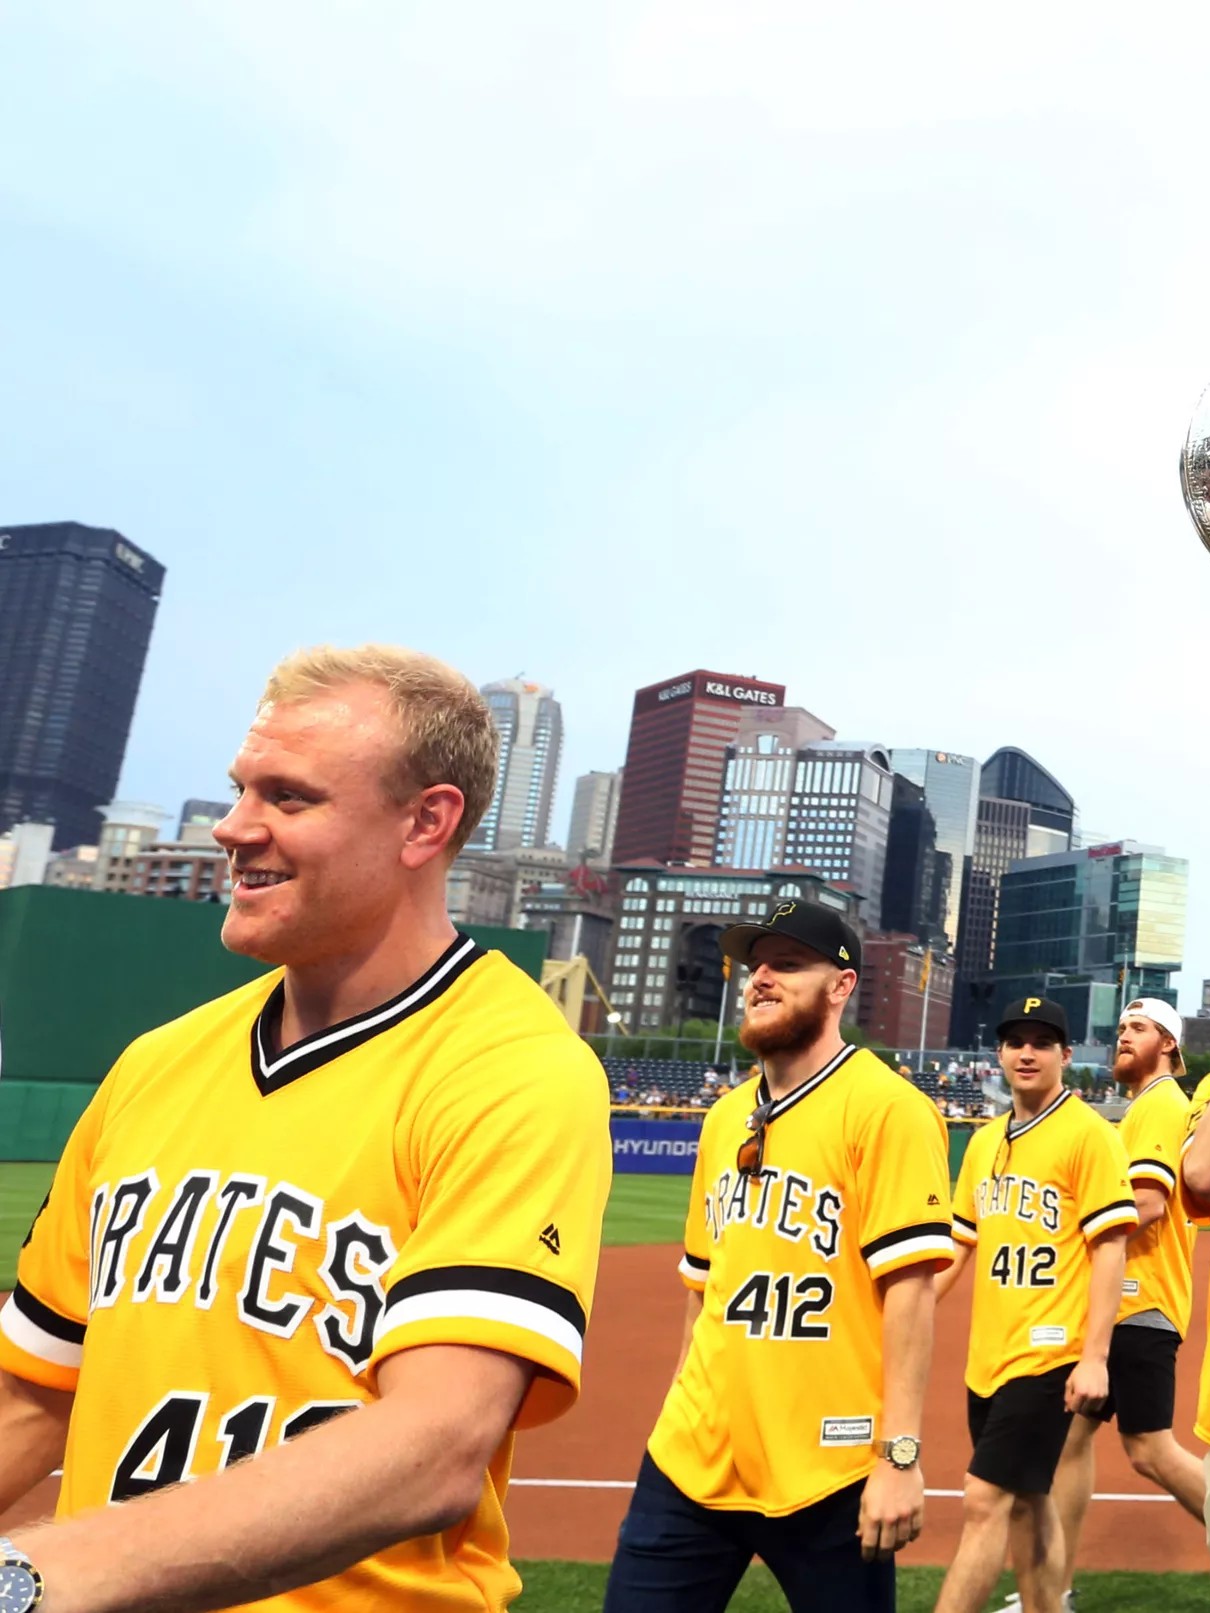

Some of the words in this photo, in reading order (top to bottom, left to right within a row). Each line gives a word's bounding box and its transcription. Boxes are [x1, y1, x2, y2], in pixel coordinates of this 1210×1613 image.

[705, 681, 731, 698] K&L
[732, 687, 777, 706] GATES
[1023, 997, 1042, 1014] P
[613, 1139, 699, 1156] HYUNDA
[89, 1170, 393, 1370] IRATES
[990, 1244, 1057, 1287] 412
[724, 1272, 836, 1340] 412
[109, 1394, 364, 1504] 41
